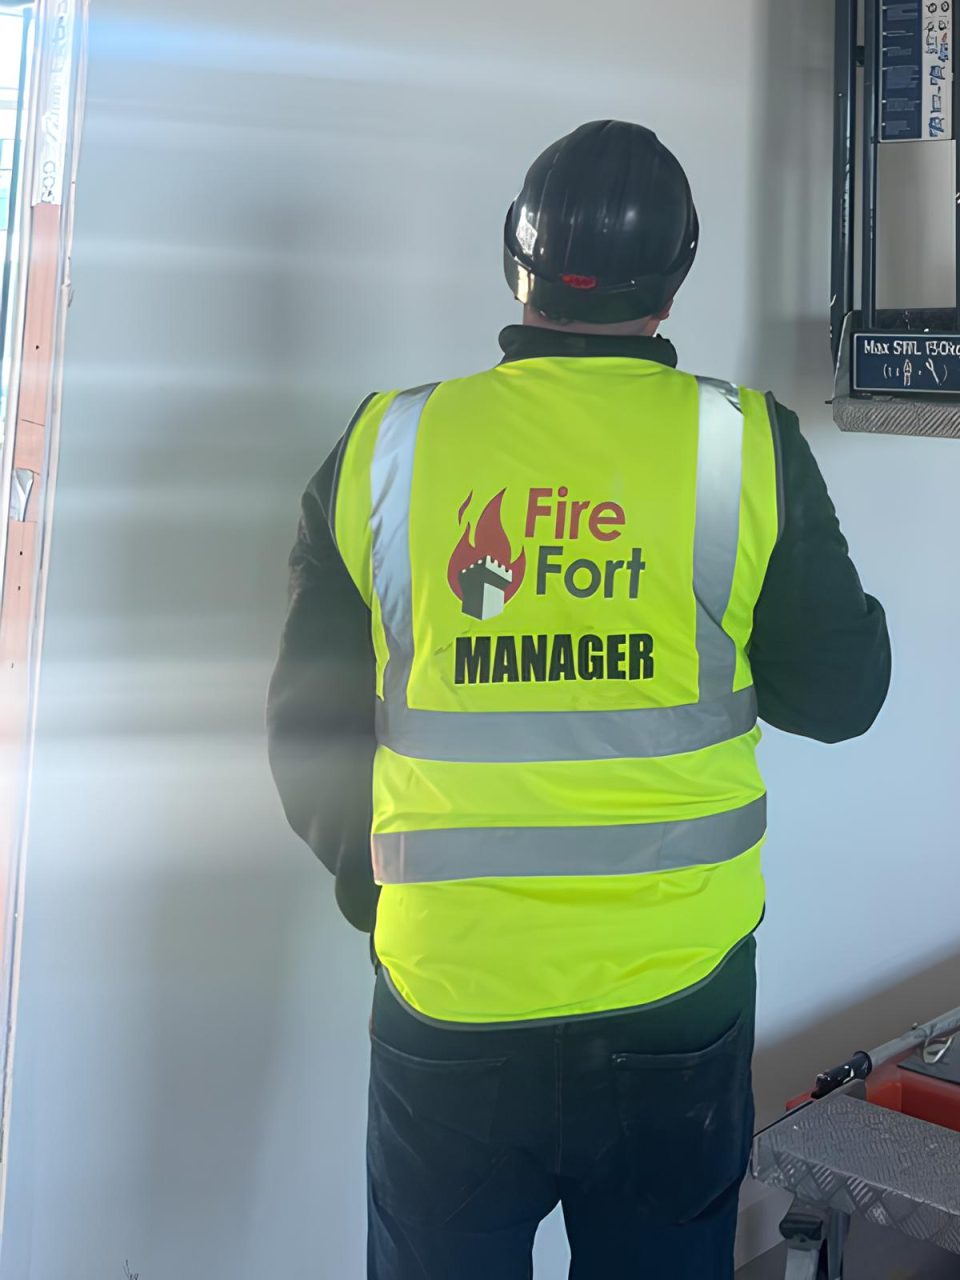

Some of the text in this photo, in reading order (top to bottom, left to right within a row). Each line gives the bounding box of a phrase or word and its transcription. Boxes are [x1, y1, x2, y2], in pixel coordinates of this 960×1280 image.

[864, 339, 890, 354] Max
[524, 486, 626, 541] Fire
[536, 545, 646, 599] Fort
[454, 633, 655, 685] MANAGER
